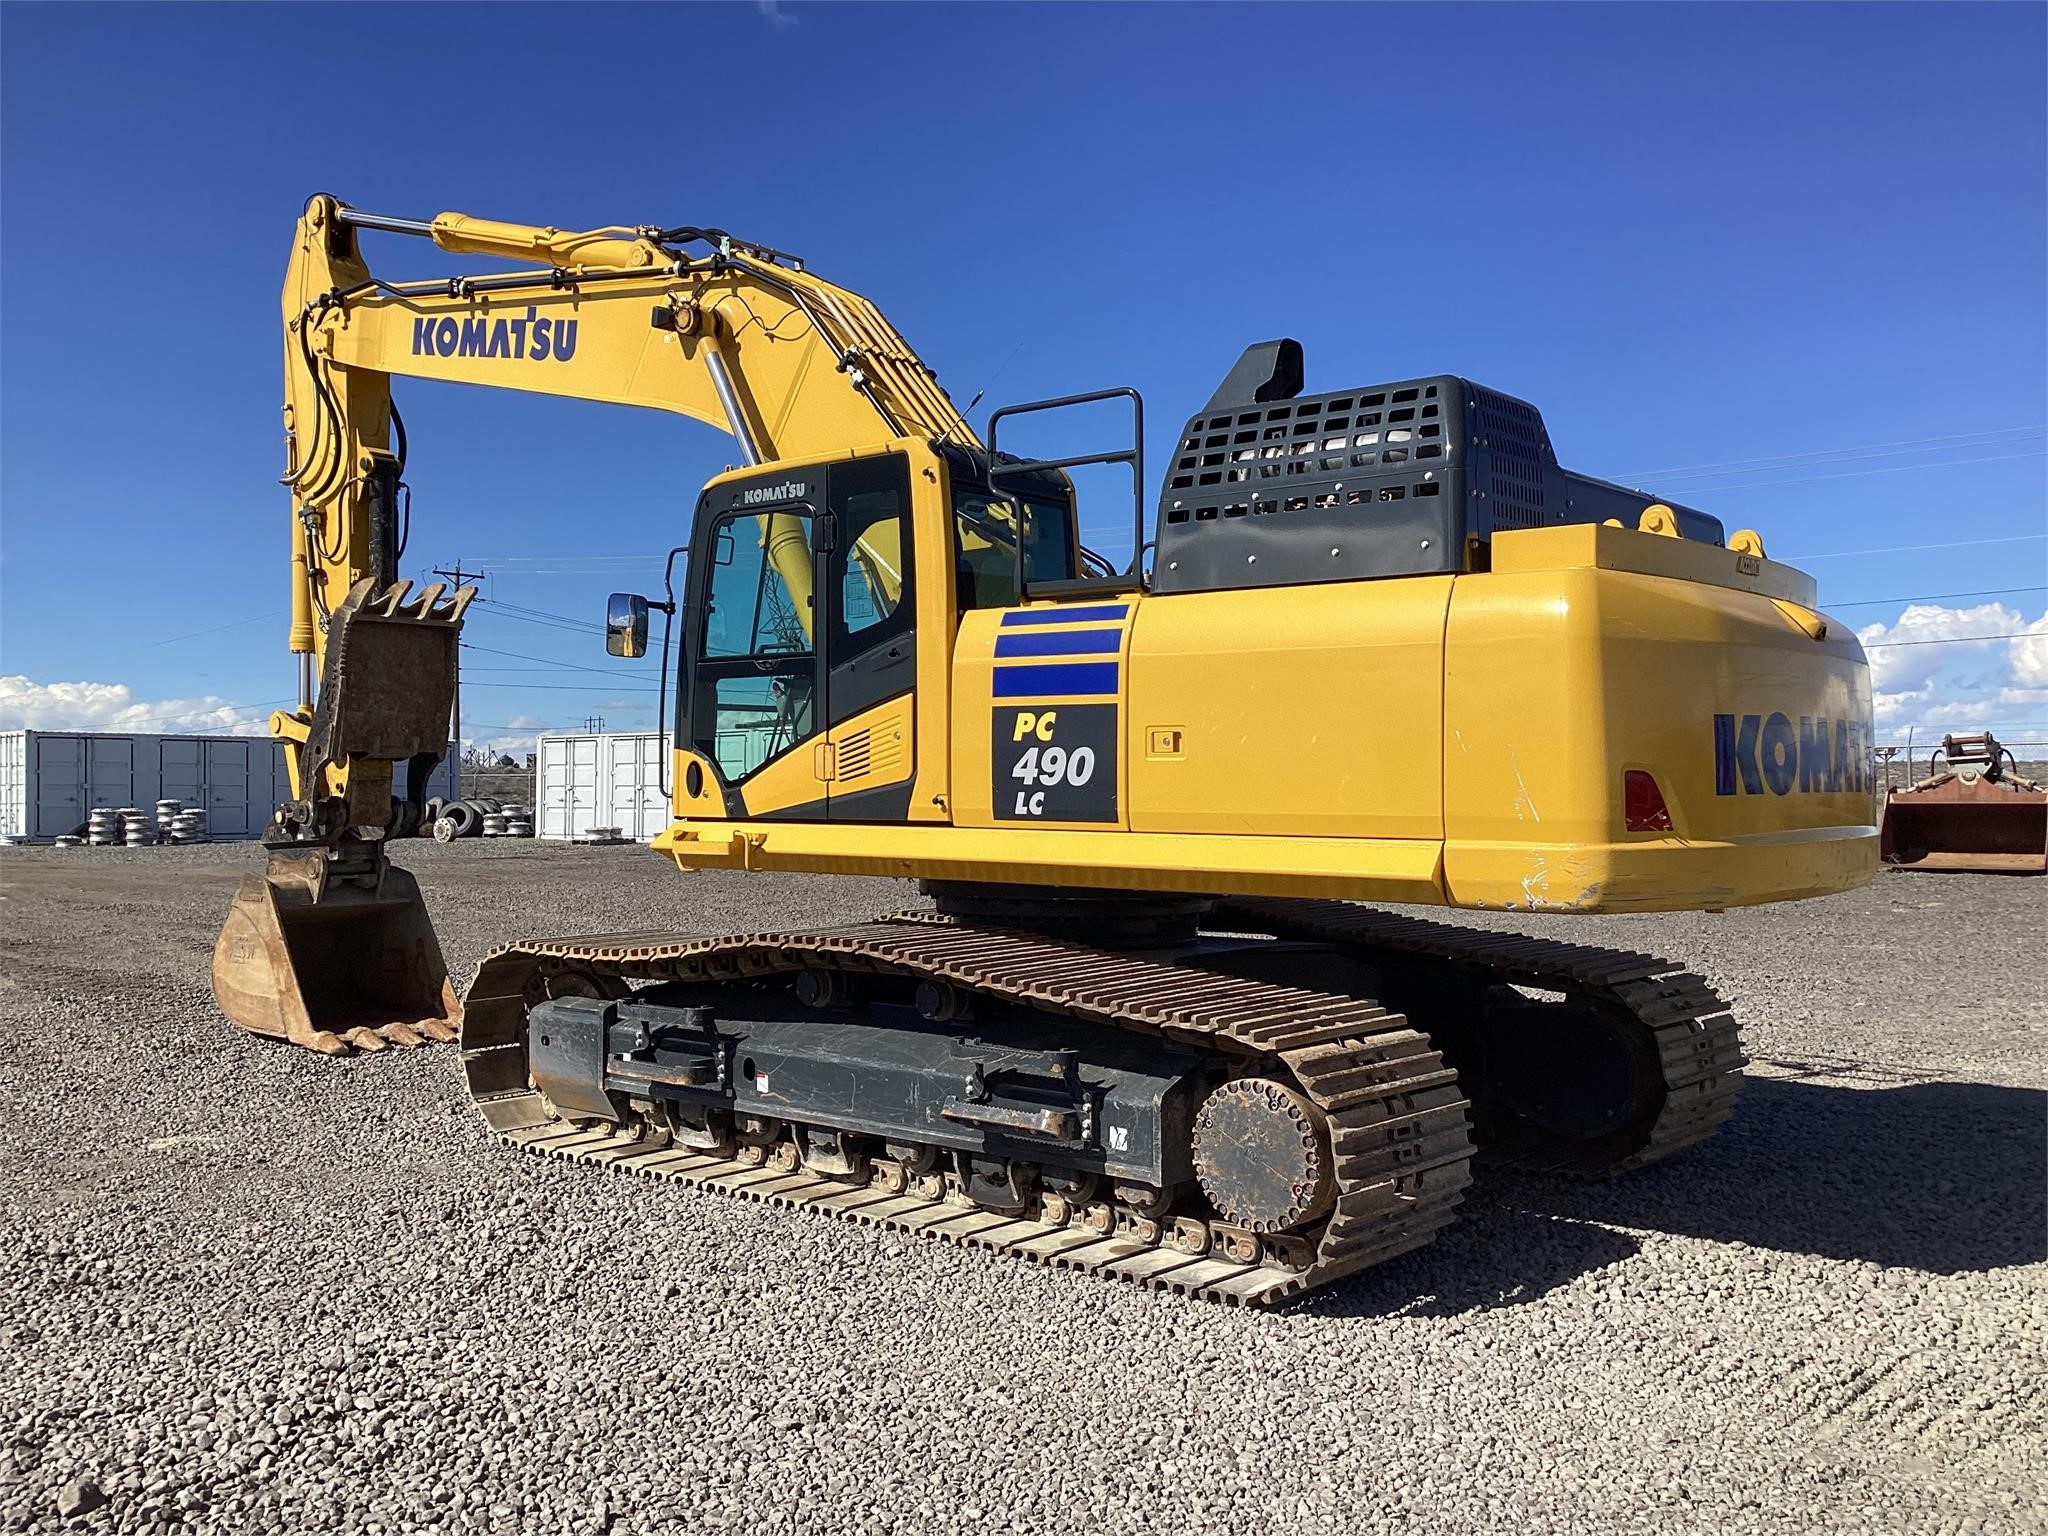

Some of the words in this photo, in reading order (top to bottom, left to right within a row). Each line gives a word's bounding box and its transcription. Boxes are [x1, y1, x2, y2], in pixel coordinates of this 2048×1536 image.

[412, 306, 578, 362] KOMATSU
[744, 481, 805, 504] KOMATSU
[1012, 711, 1057, 742] PC
[1011, 746, 1095, 787] 490
[1014, 791, 1045, 815] LC
